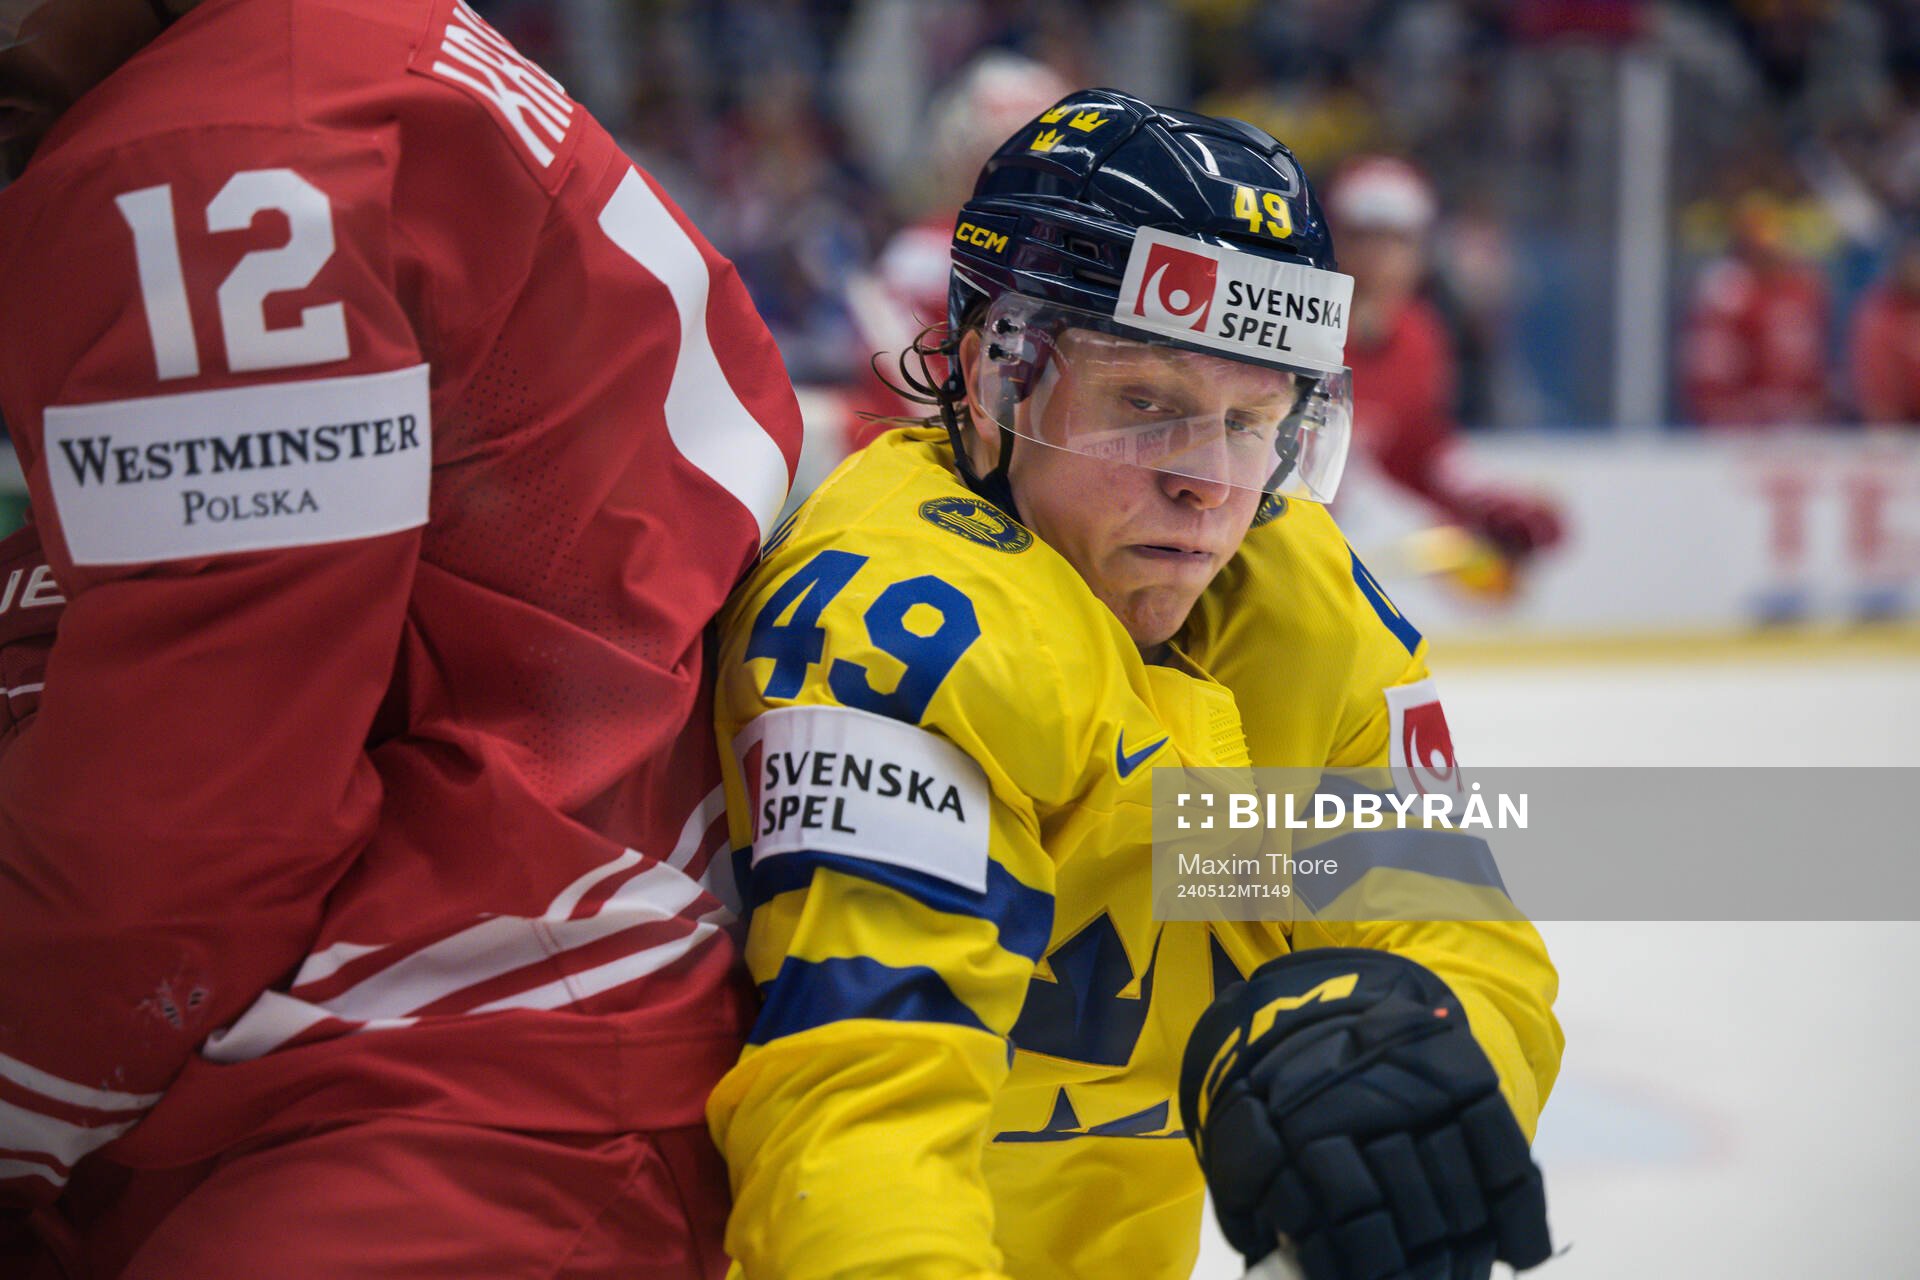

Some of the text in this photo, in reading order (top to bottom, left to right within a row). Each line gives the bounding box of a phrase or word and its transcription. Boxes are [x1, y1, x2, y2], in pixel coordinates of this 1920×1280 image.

[955, 221, 1009, 254] CCM
[1234, 186, 1293, 240] 49
[114, 168, 351, 381] 12
[1225, 279, 1342, 330] SVENSKA
[1217, 311, 1292, 352] SPEL
[744, 549, 982, 724] 49
[763, 750, 967, 824] SVENSKA
[761, 796, 857, 838] SPEL
